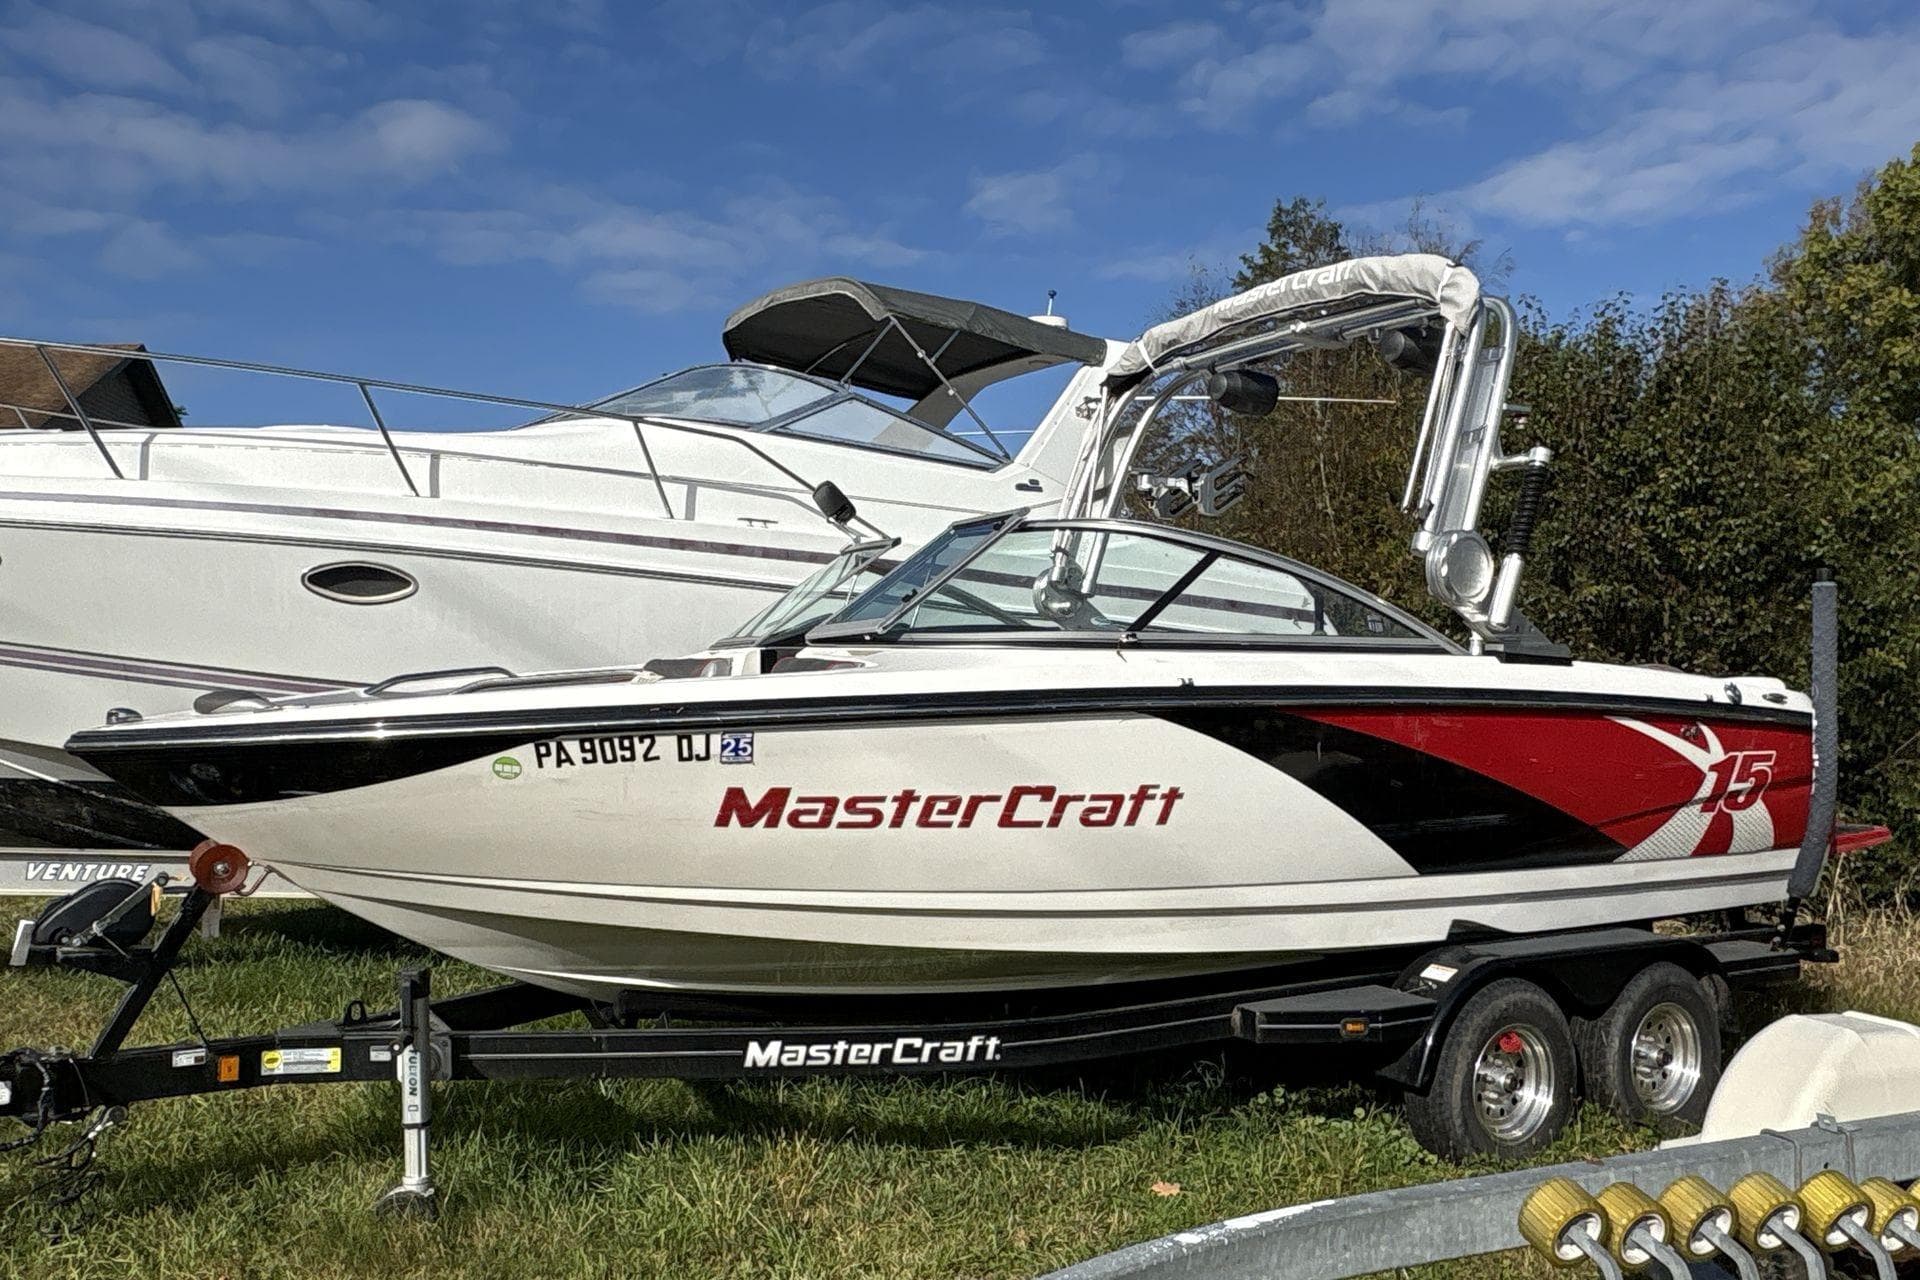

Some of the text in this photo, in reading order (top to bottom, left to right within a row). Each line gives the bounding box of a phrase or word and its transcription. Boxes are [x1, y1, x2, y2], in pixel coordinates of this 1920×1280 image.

[534, 740, 576, 768] PA
[578, 735, 660, 764] 9092
[721, 738, 752, 756] 25
[713, 784, 1186, 829] MasterCraft
[26, 862, 151, 882] VENTURE
[743, 1035, 1001, 1068] MasterCraft
